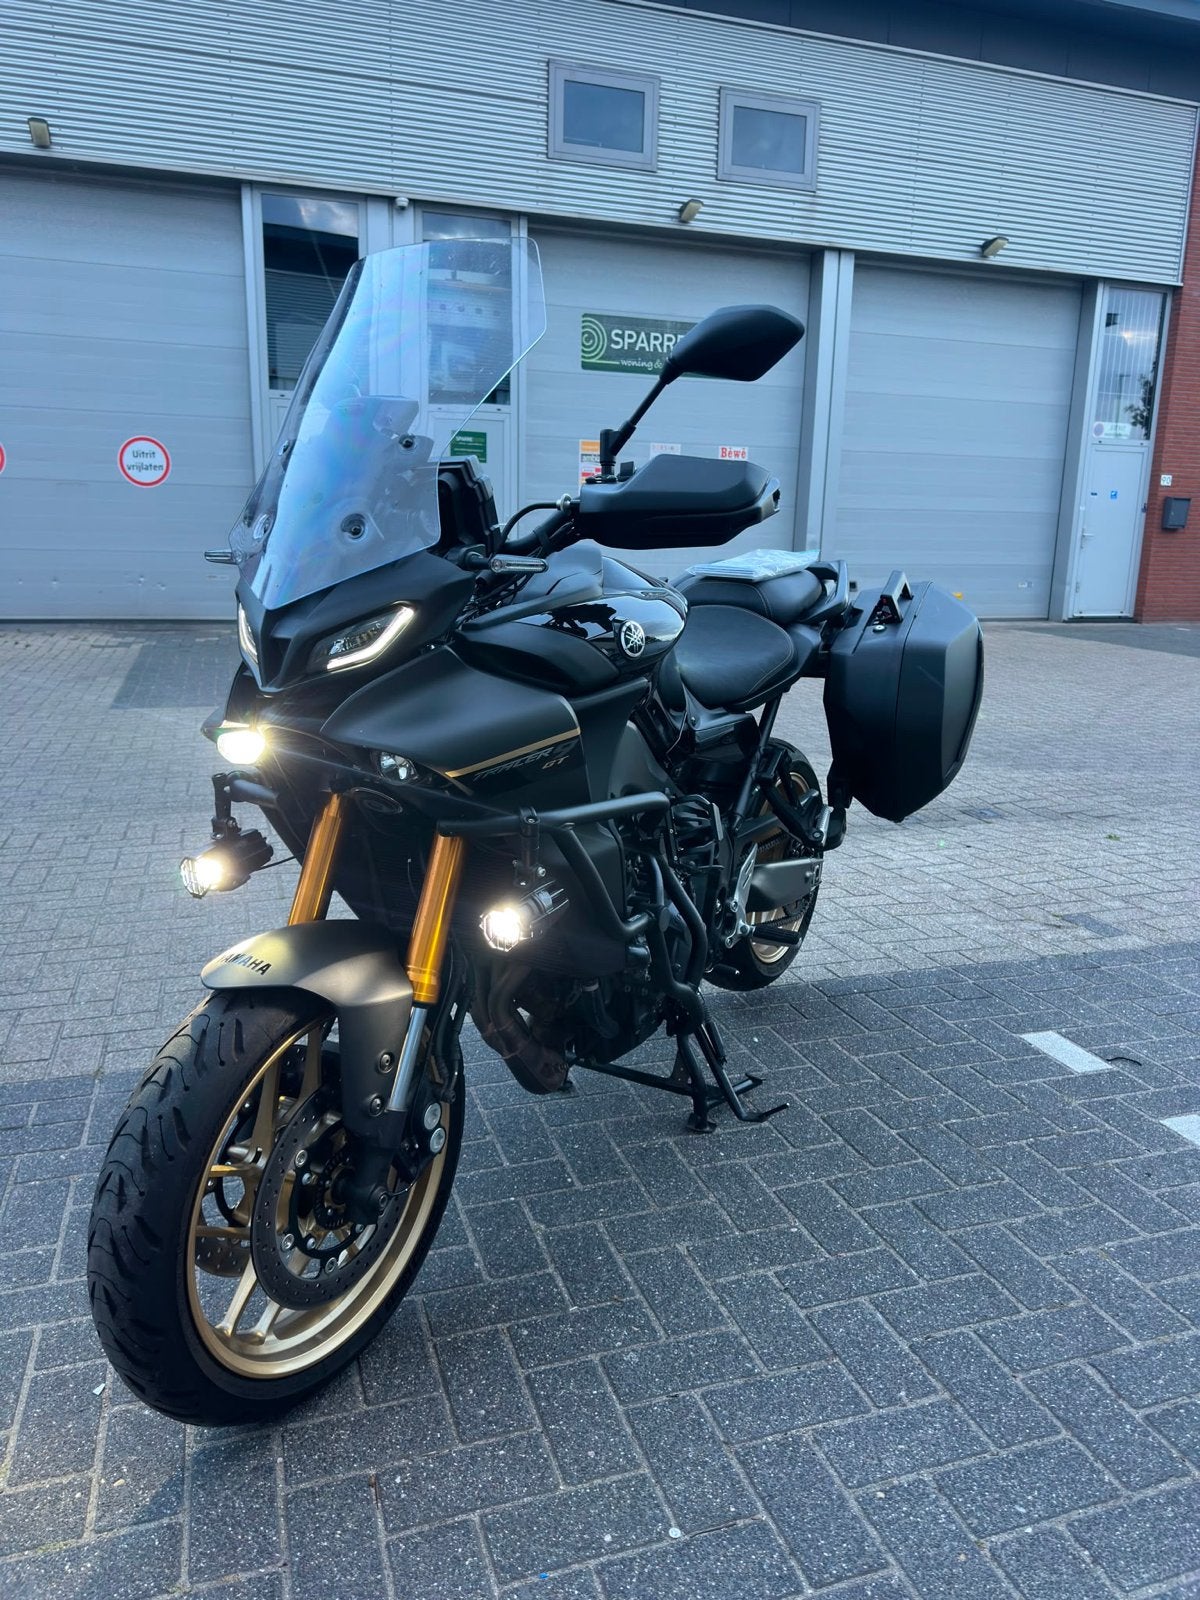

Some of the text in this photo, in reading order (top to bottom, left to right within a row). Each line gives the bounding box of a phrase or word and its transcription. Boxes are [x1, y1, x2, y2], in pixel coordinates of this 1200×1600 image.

[620, 357, 653, 371] woning
[132, 450, 156, 458] Uitrit
[126, 462, 164, 472] vrijlaten
[215, 953, 272, 976] AMAHA
